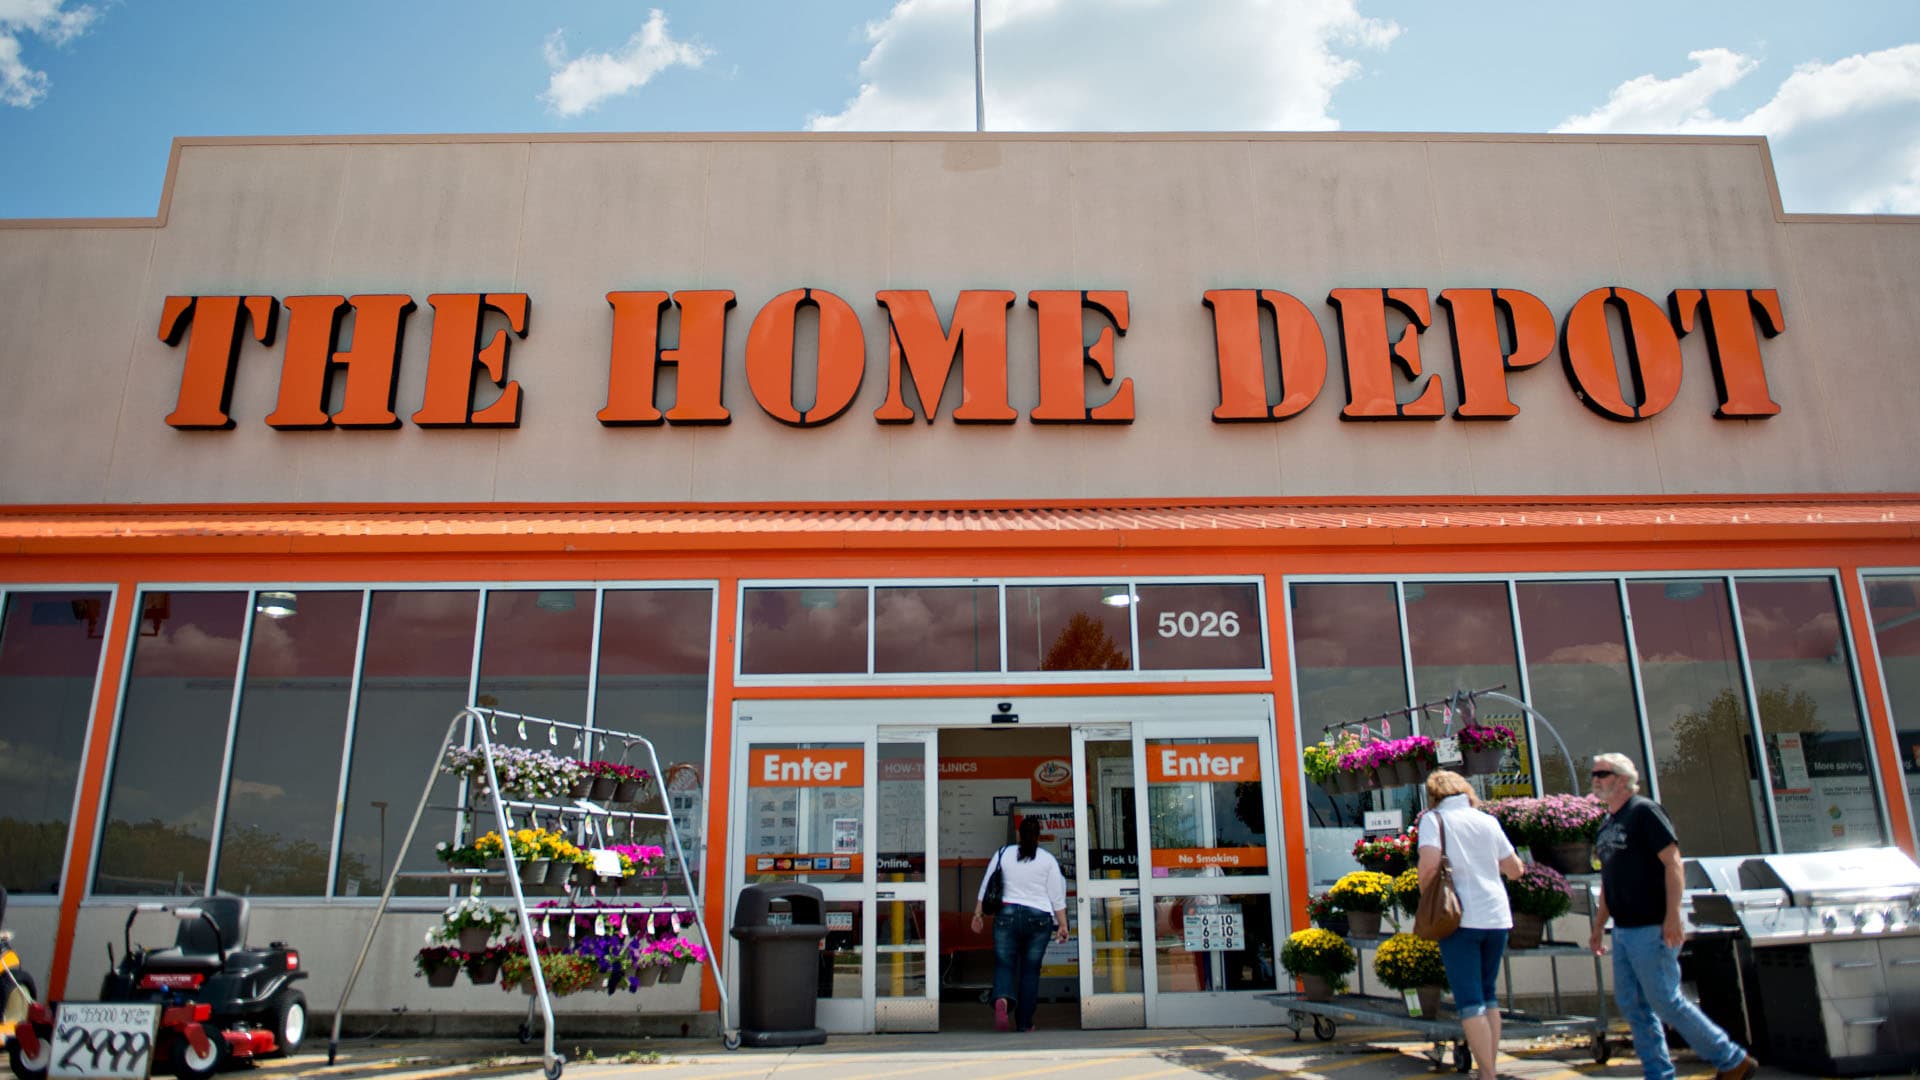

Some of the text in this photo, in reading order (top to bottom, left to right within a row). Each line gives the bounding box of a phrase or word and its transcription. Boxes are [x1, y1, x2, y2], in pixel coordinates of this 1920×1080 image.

[158, 286, 1786, 430] THE HOME DEPOT
[1158, 611, 1240, 638] 5026
[763, 754, 848, 782] Enter
[885, 763, 926, 773] HOW-T
[1161, 750, 1244, 777] Enter
[1814, 761, 1835, 770] More
[1103, 855, 1125, 864] Pick
[1178, 853, 1239, 865] No Smoking
[1202, 915, 1209, 926] 6
[1221, 914, 1233, 926] 10
[1203, 926, 1210, 937] 6
[1222, 926, 1234, 937] 10
